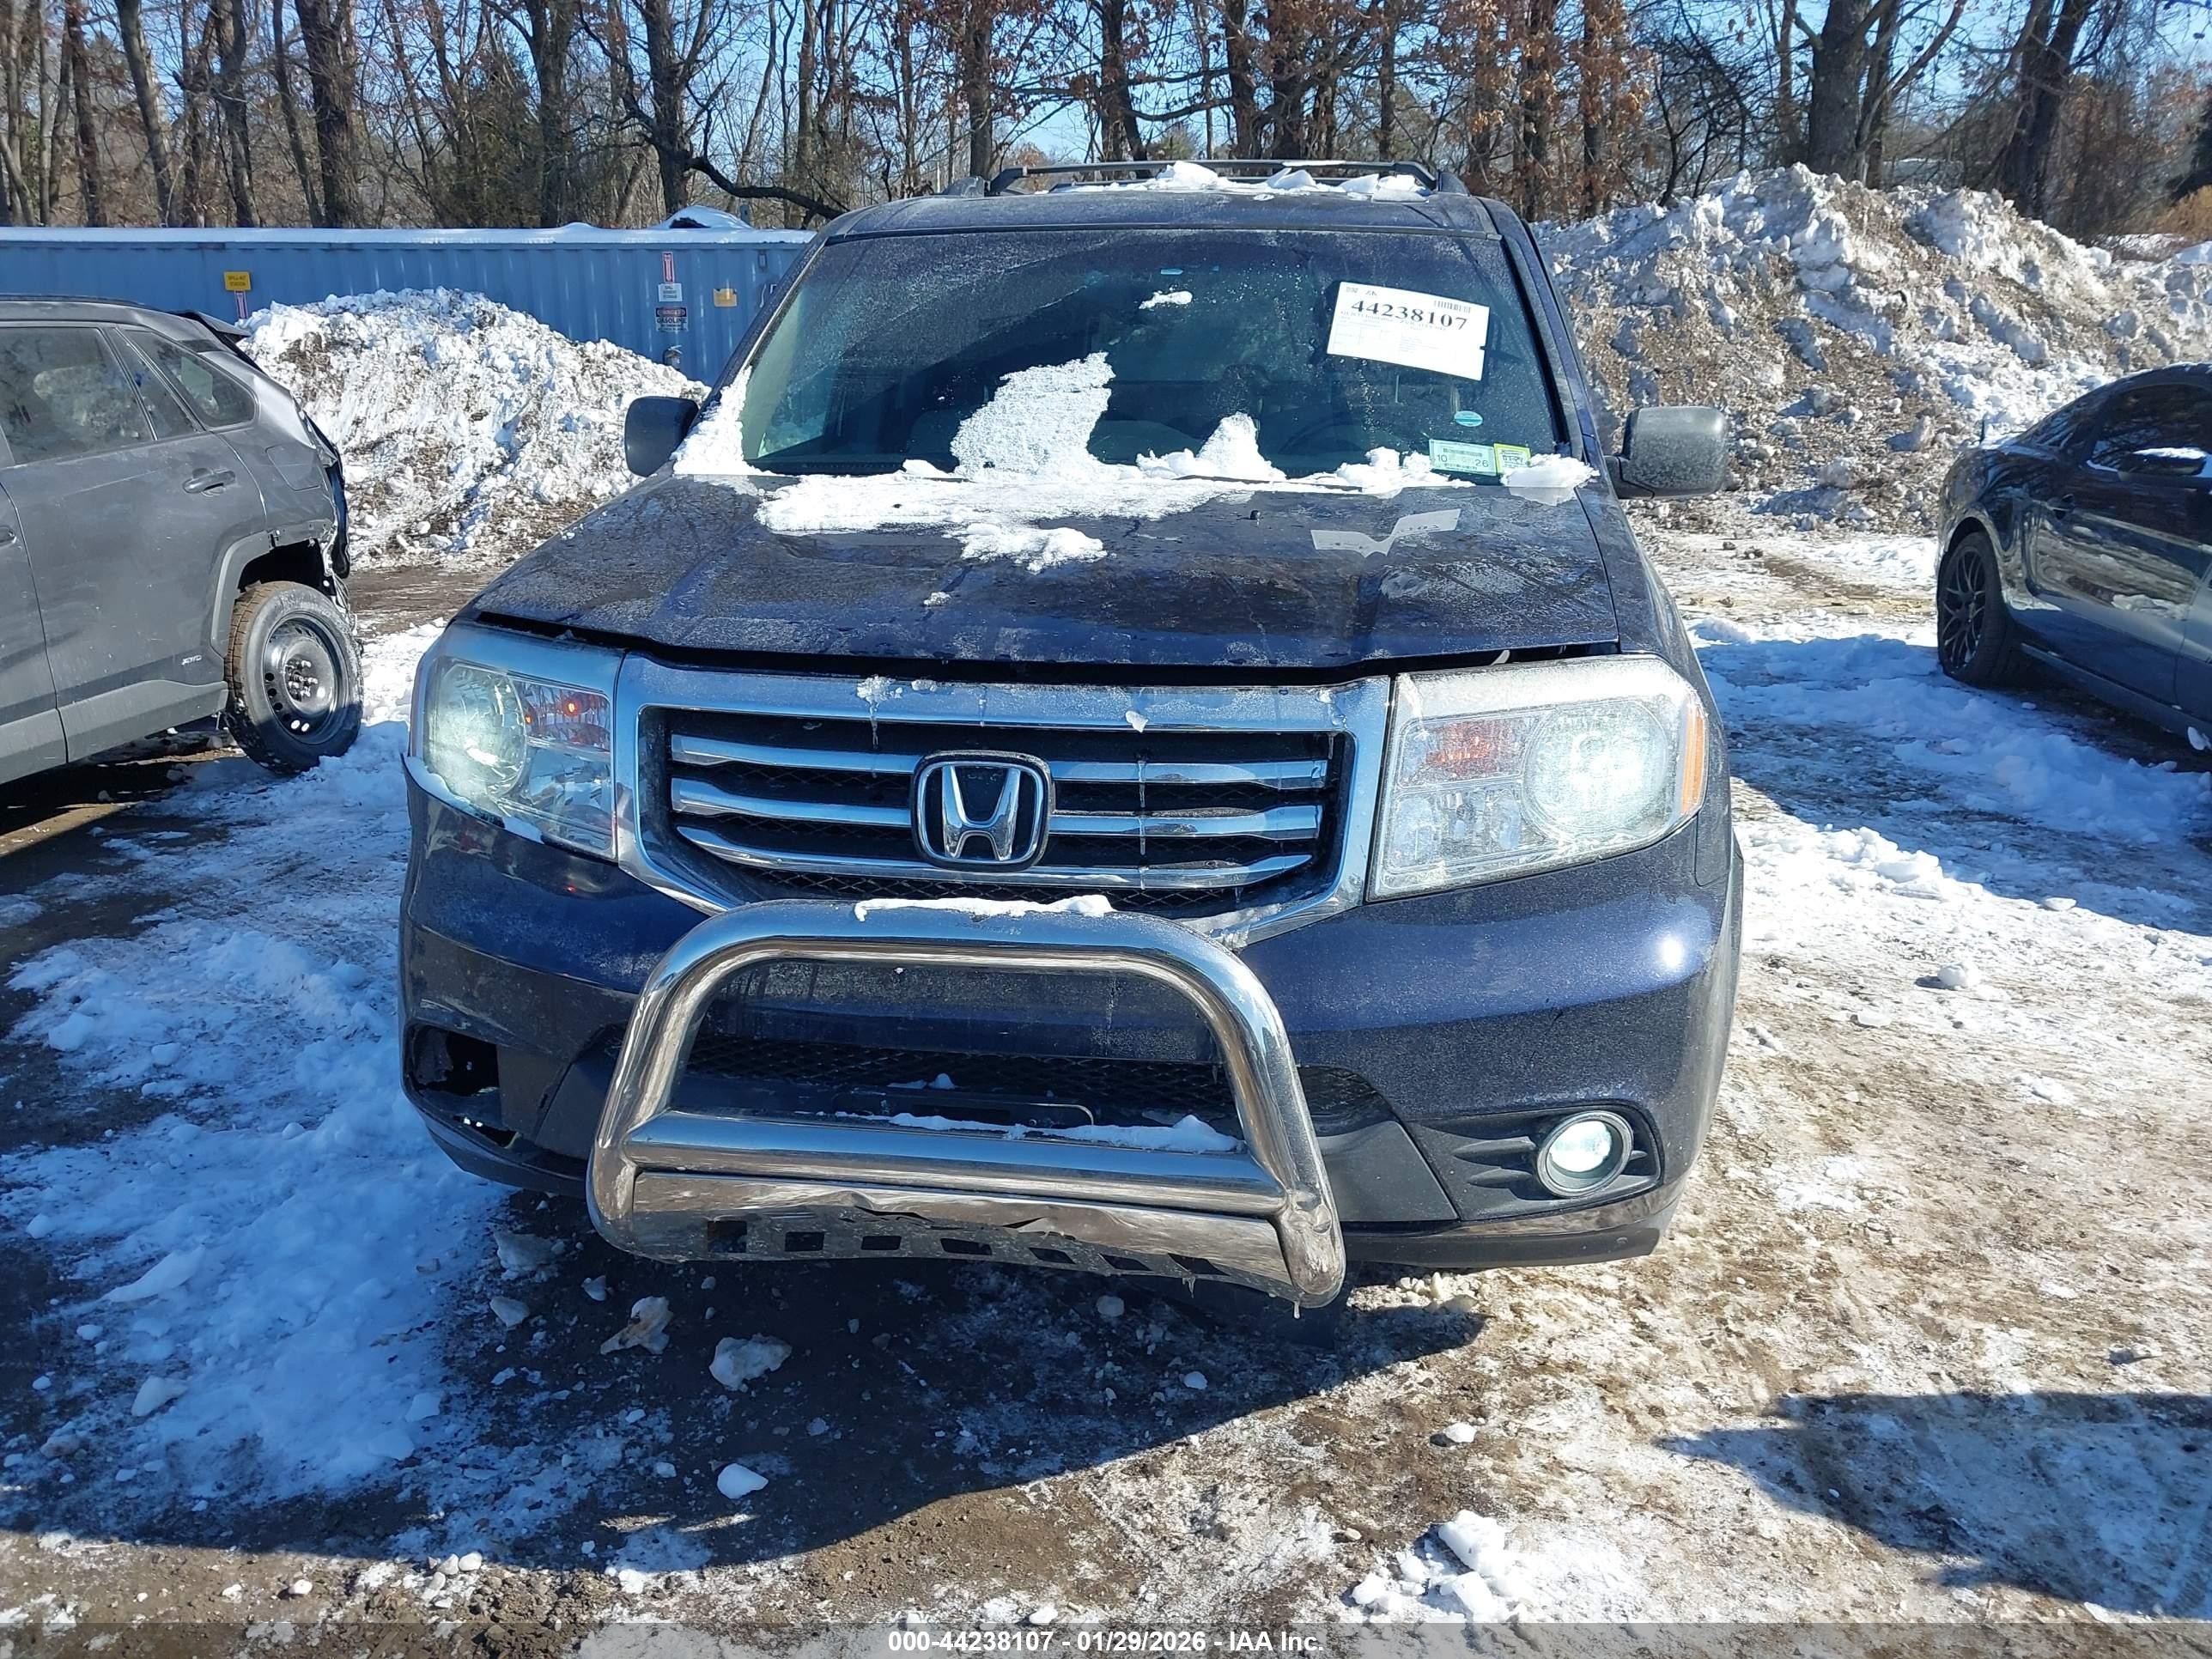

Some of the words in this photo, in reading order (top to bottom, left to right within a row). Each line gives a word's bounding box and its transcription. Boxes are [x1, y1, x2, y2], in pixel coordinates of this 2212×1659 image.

[1352, 300, 1468, 330] 44238107
[1437, 454, 1448, 463] 10
[1474, 459, 1489, 467] 26
